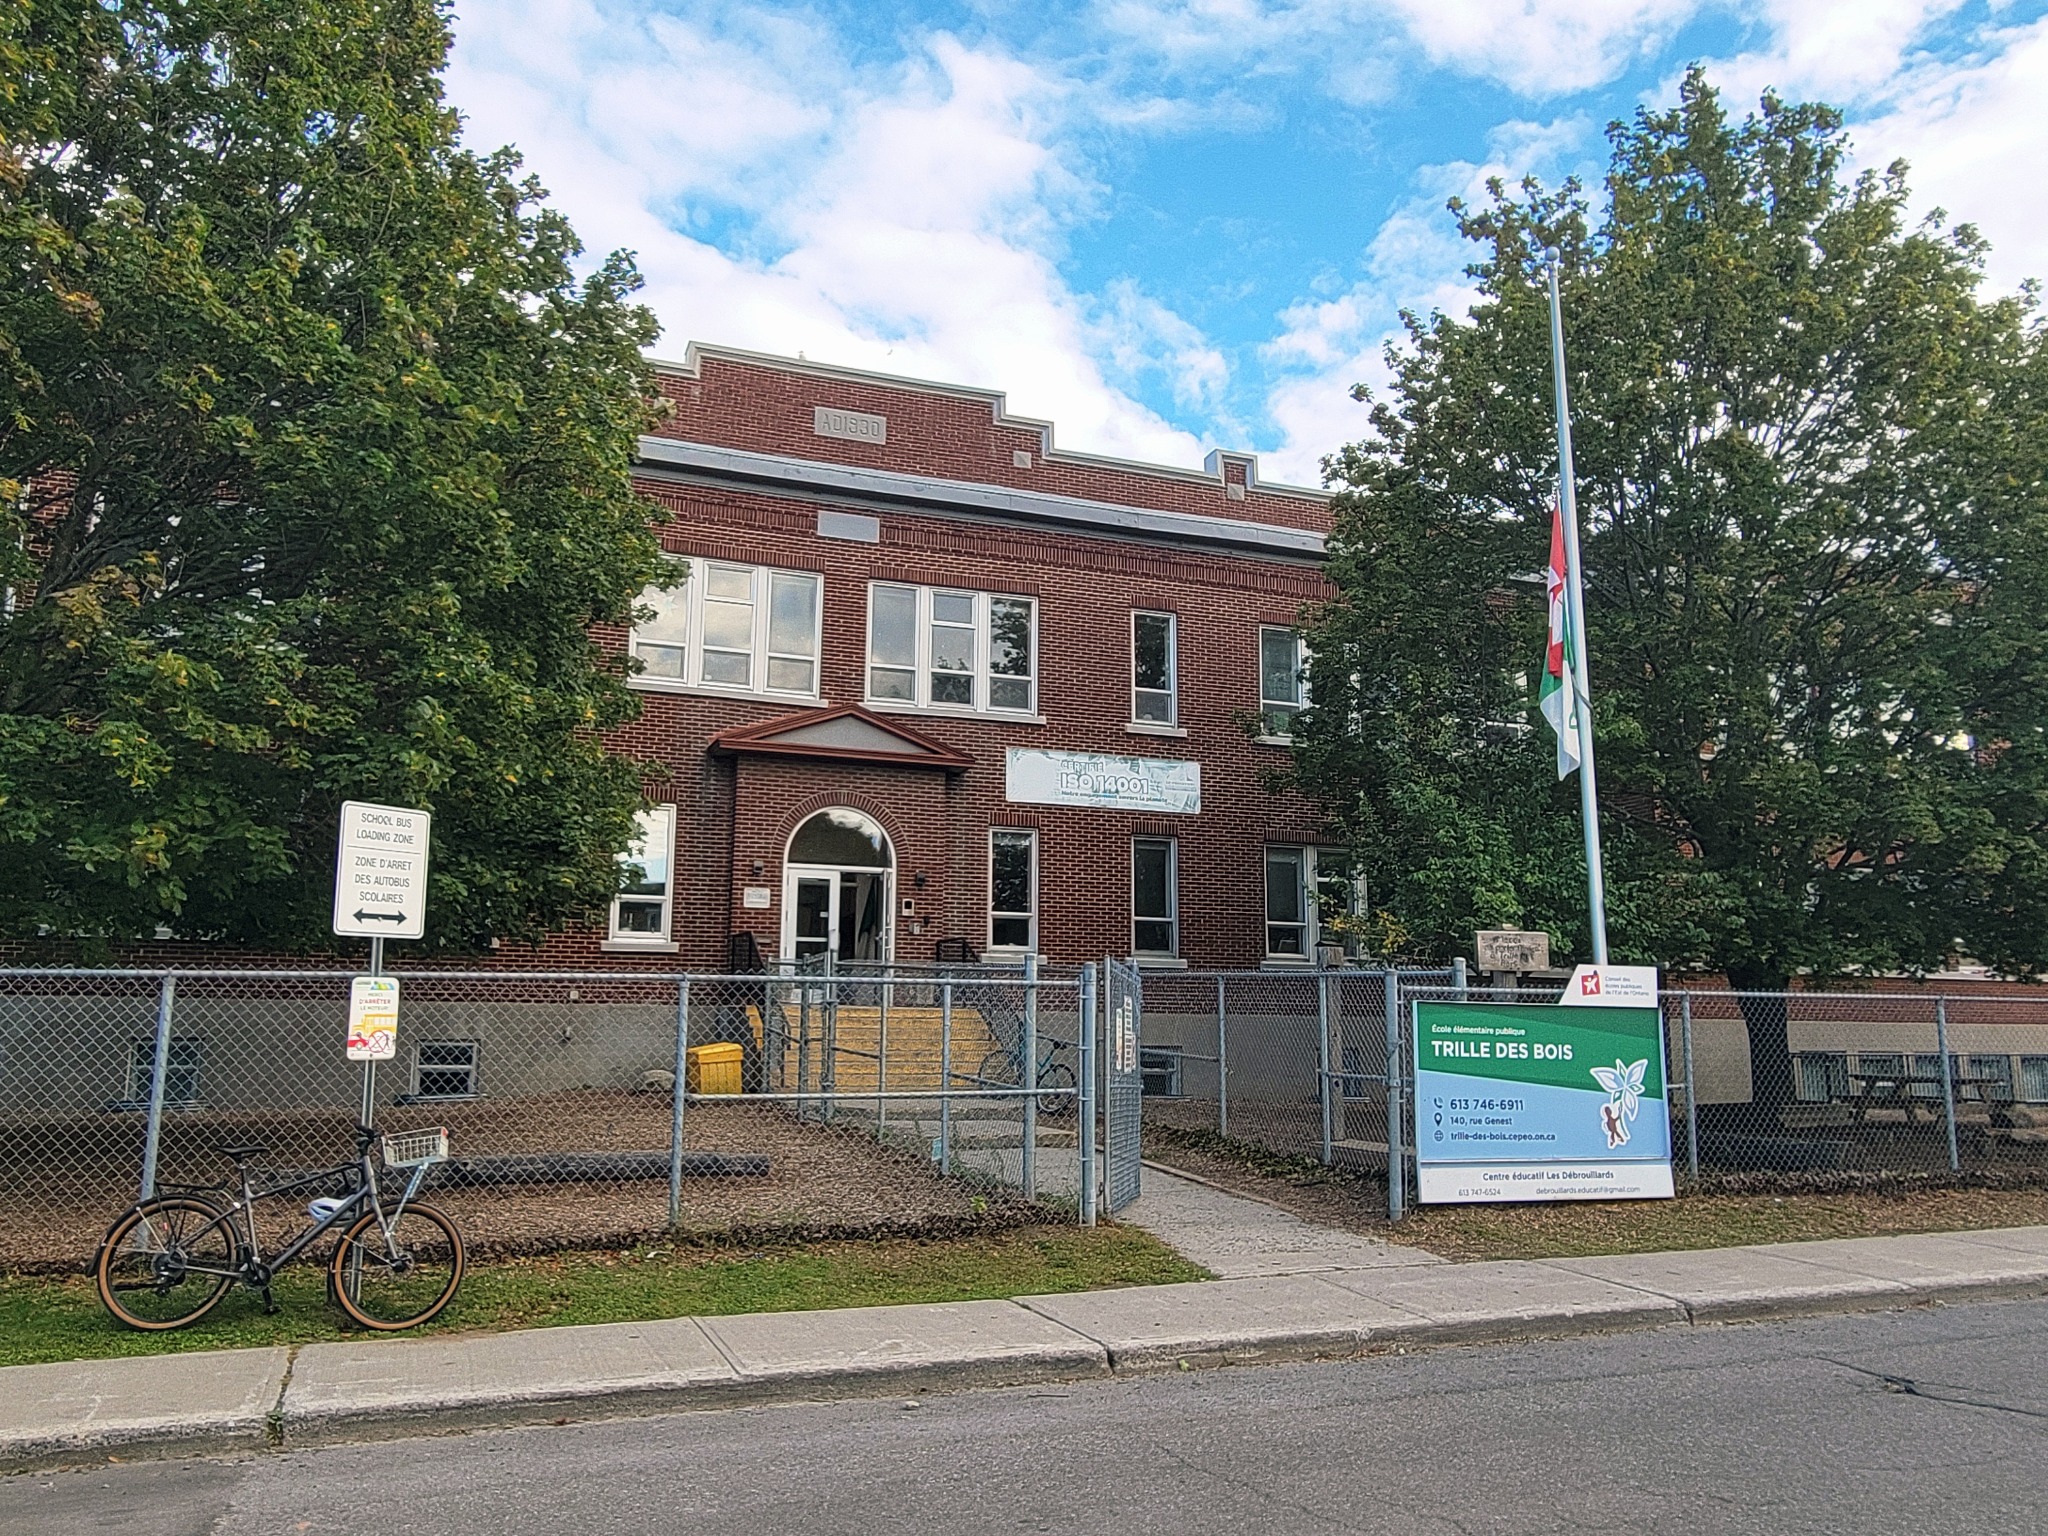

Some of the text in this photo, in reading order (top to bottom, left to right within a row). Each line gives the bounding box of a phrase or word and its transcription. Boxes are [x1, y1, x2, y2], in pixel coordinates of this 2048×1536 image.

[1060, 773, 1093, 790] ISO
[1096, 774, 1149, 794] 14001
[361, 812, 412, 828] SCHOOL BUS
[356, 829, 414, 844] LOADING ZONE
[355, 856, 377, 867] ZONE
[355, 873, 410, 888] DES AUTOBUS
[359, 891, 404, 904] SCOLAIRES
[1431, 1024, 1526, 1037] École élémentaire publique
[1431, 1041, 1573, 1061] TRILLE DES BOIS
[1450, 1099, 1524, 1111] 613 746-6911
[1450, 1116, 1513, 1127] 140, rue Genest
[1450, 1131, 1556, 1143] trille-des-bois.cepeo.on.ca
[1482, 1169, 1614, 1181] Centre éducatif Les Débrouillards
[1458, 1189, 1469, 1197] 613
